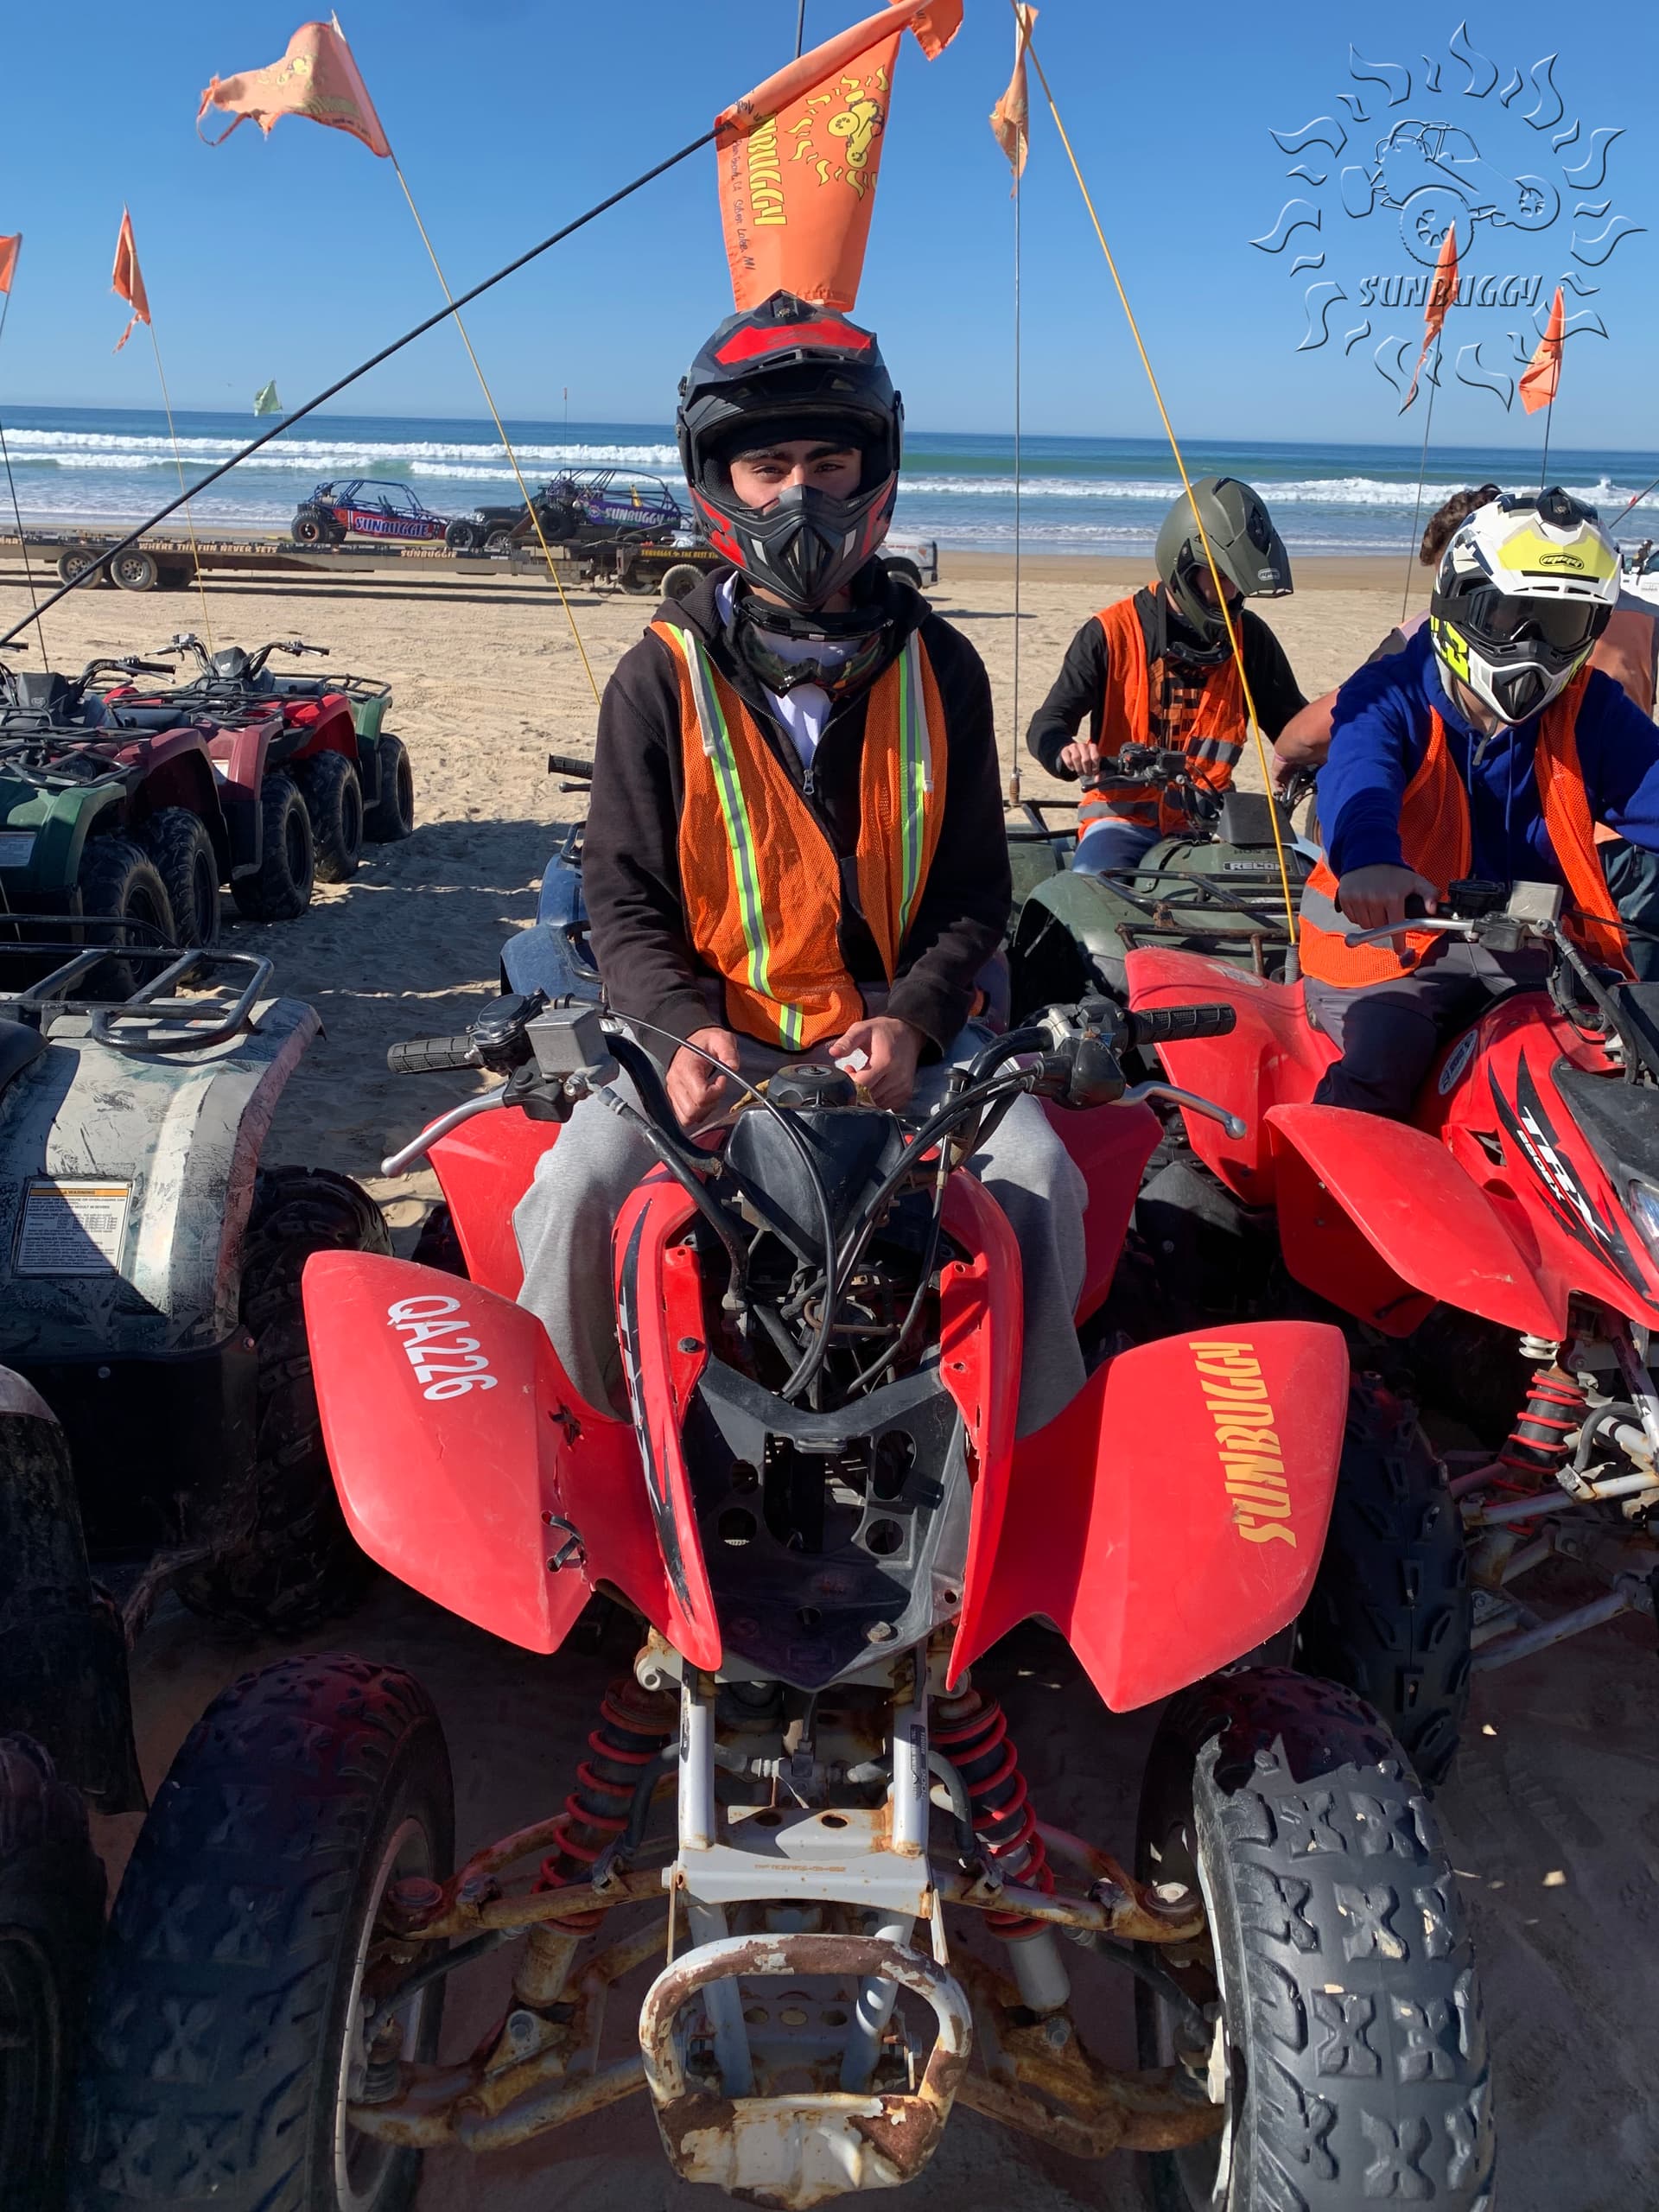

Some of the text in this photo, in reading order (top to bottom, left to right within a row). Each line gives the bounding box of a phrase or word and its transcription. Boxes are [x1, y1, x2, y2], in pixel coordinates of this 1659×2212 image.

[747, 118, 787, 226] BUGGY
[743, 256, 756, 270] MI
[354, 516, 430, 537] SUNBUGGIE
[605, 506, 664, 524] SUNBUGGY
[138, 542, 174, 550] WHERE
[220, 544, 252, 553] NEVER
[255, 545, 277, 554] SETS
[400, 550, 458, 558] SUNBUGGIE
[1516, 1129, 1567, 1201] 250EX
[1521, 1105, 1611, 1243] TRX
[387, 1295, 499, 1401] QA226
[1188, 1342, 1297, 1548] SUNBUGGY
